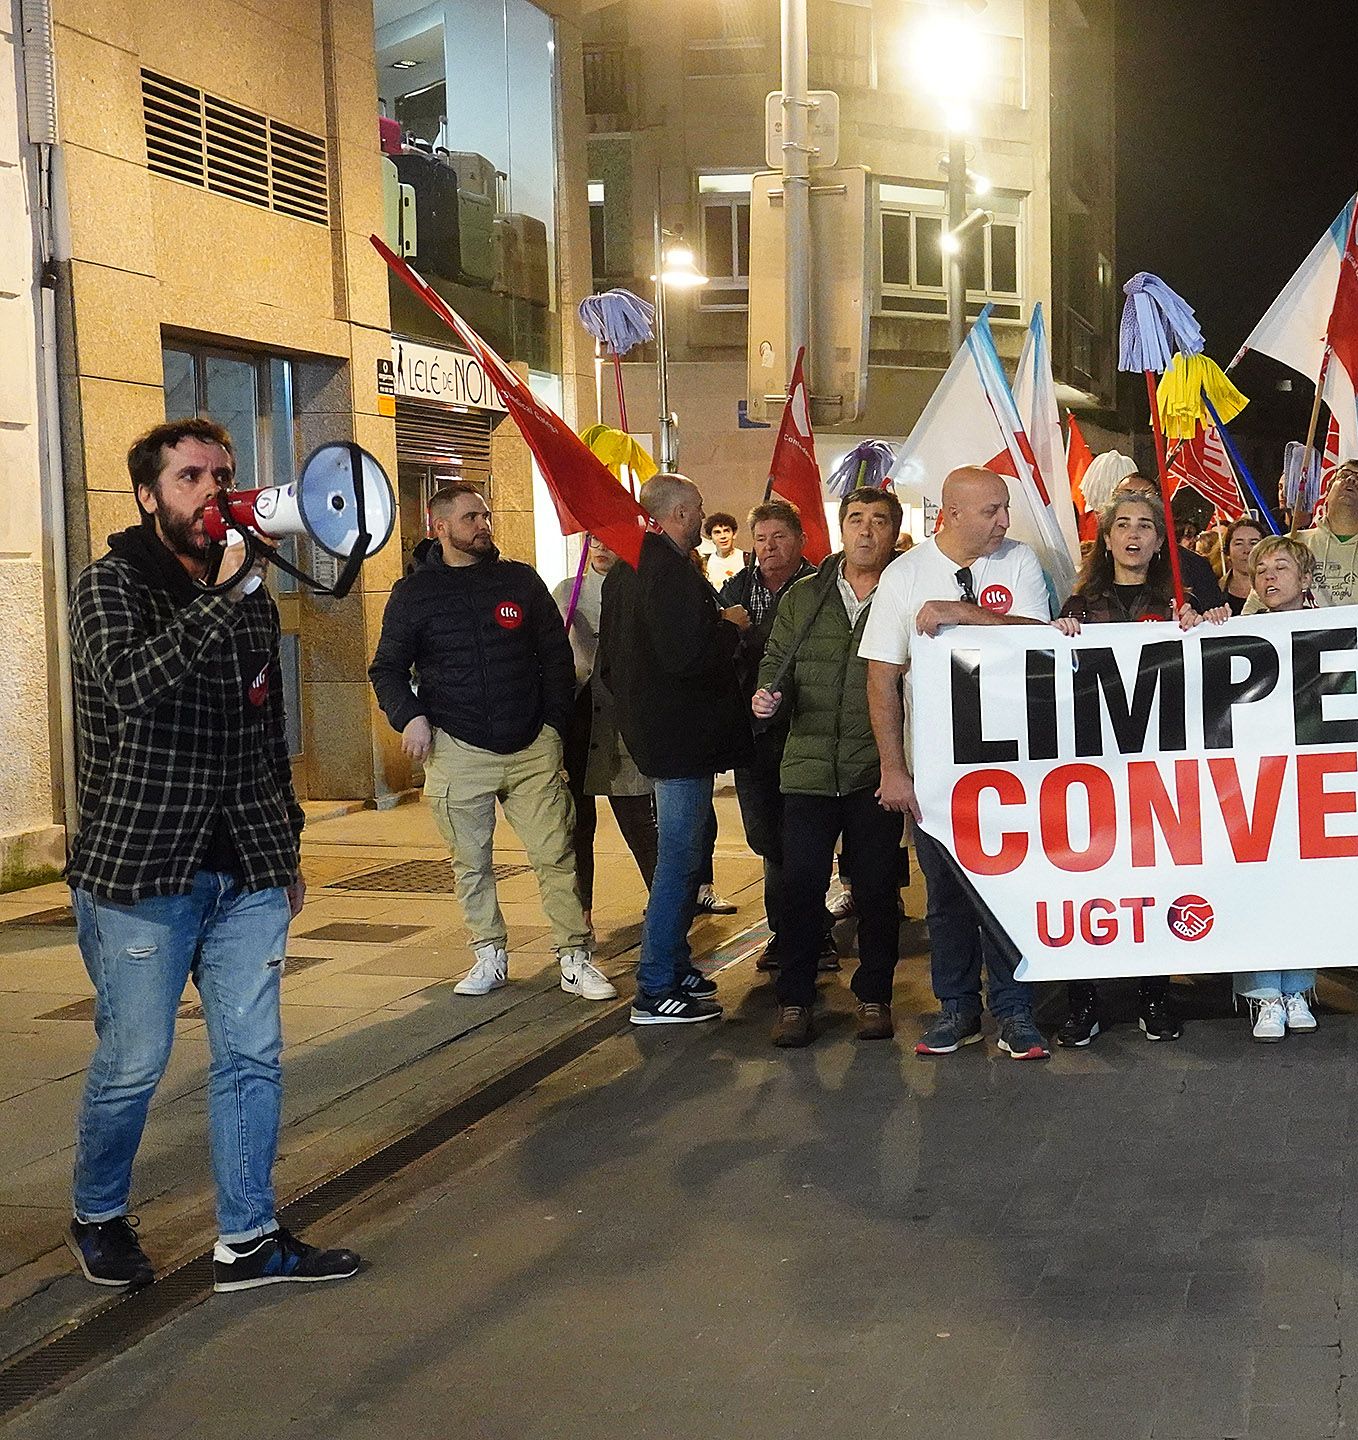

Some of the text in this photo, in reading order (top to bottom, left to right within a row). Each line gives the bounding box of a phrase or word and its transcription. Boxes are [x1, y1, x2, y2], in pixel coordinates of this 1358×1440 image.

[409, 355, 440, 394] LELÉ
[442, 371, 454, 391] DE
[986, 591, 1007, 603] CIG
[500, 607, 518, 618] CIG
[1037, 896, 1155, 948] UGT
